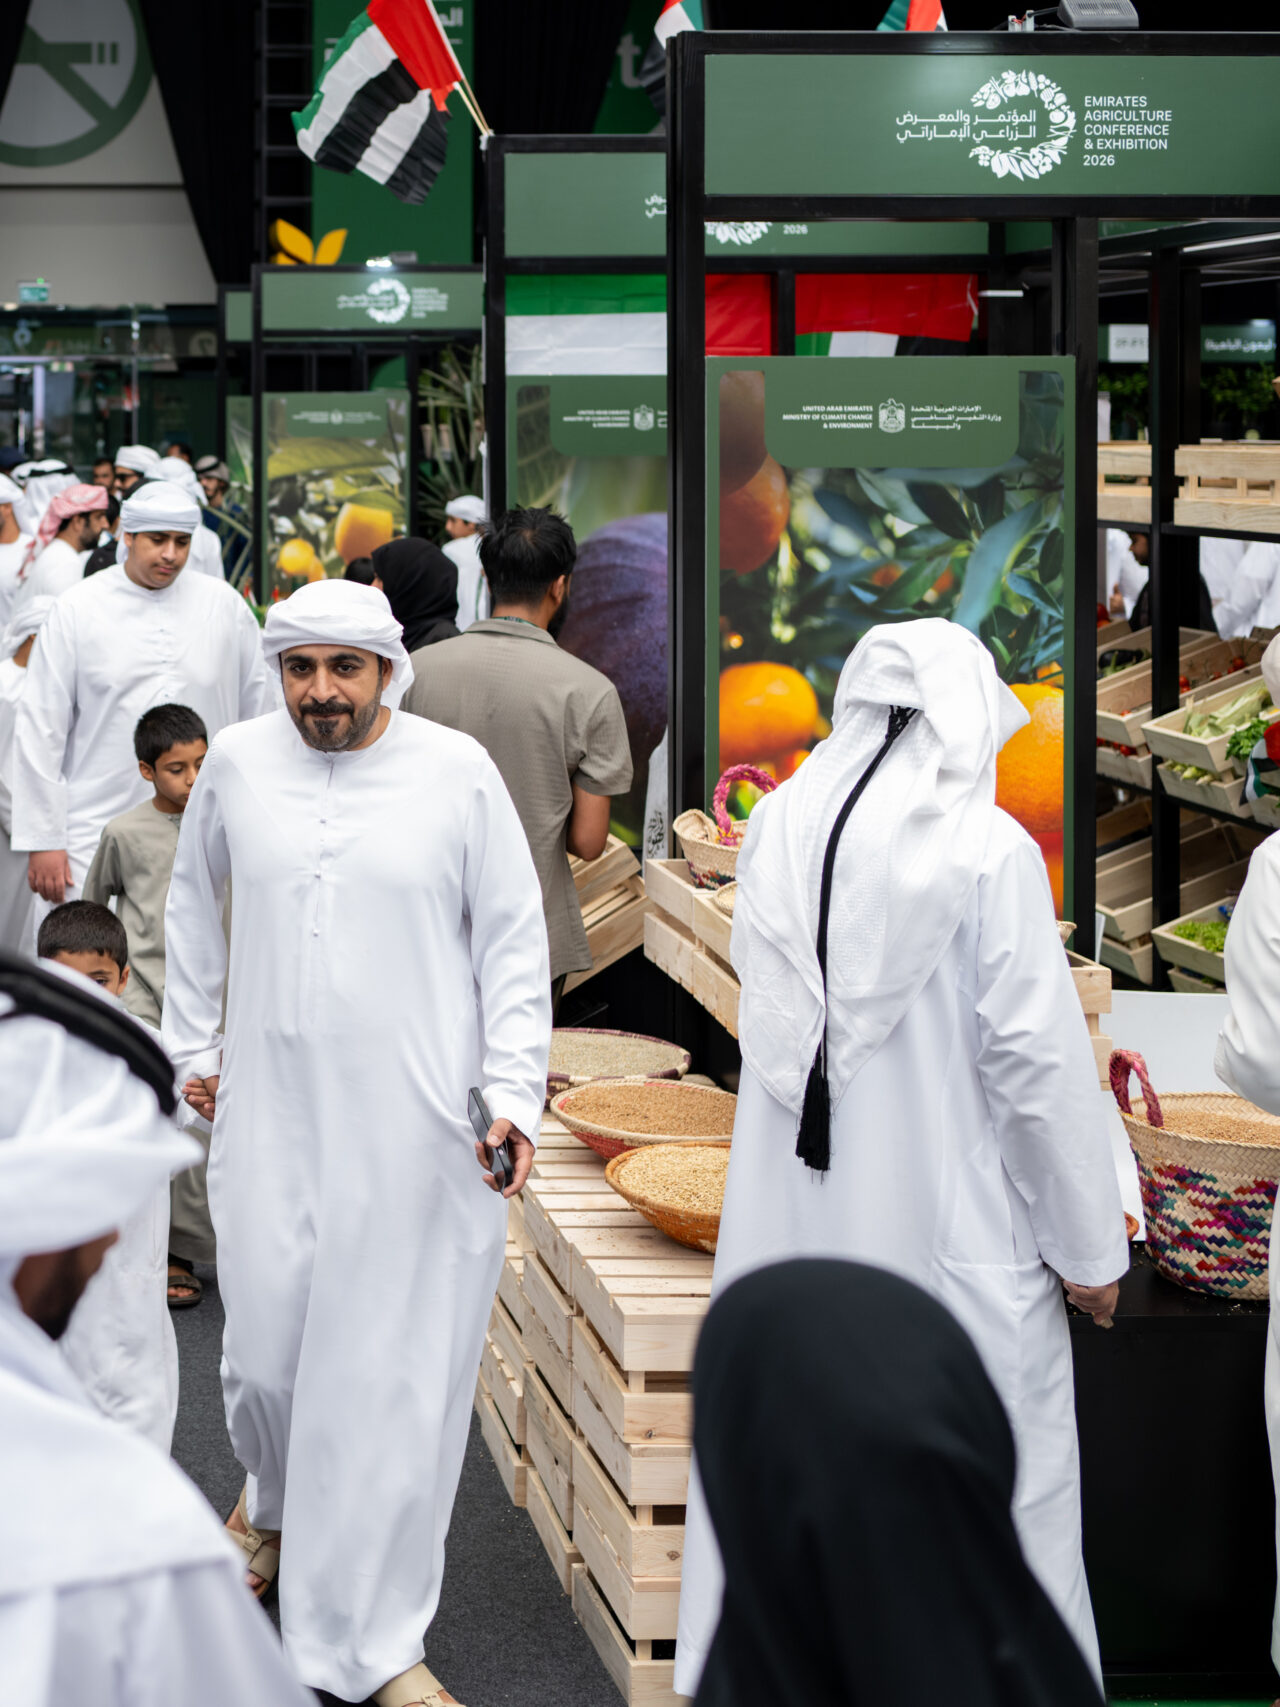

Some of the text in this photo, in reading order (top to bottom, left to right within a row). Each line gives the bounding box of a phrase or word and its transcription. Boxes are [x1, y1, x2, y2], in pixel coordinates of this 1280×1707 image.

[1085, 96, 1147, 106] EMIRATES
[896, 110, 1035, 127] المؤتمر والمعرض
[1084, 111, 1171, 121] AGRICULTURE
[896, 125, 1035, 143] الزراعي الإماراتي
[1085, 125, 1169, 135] CONFERENCE
[1085, 139, 1167, 149] & EXHIBITION
[1083, 155, 1115, 166] 2026
[784, 225, 808, 234] 2026
